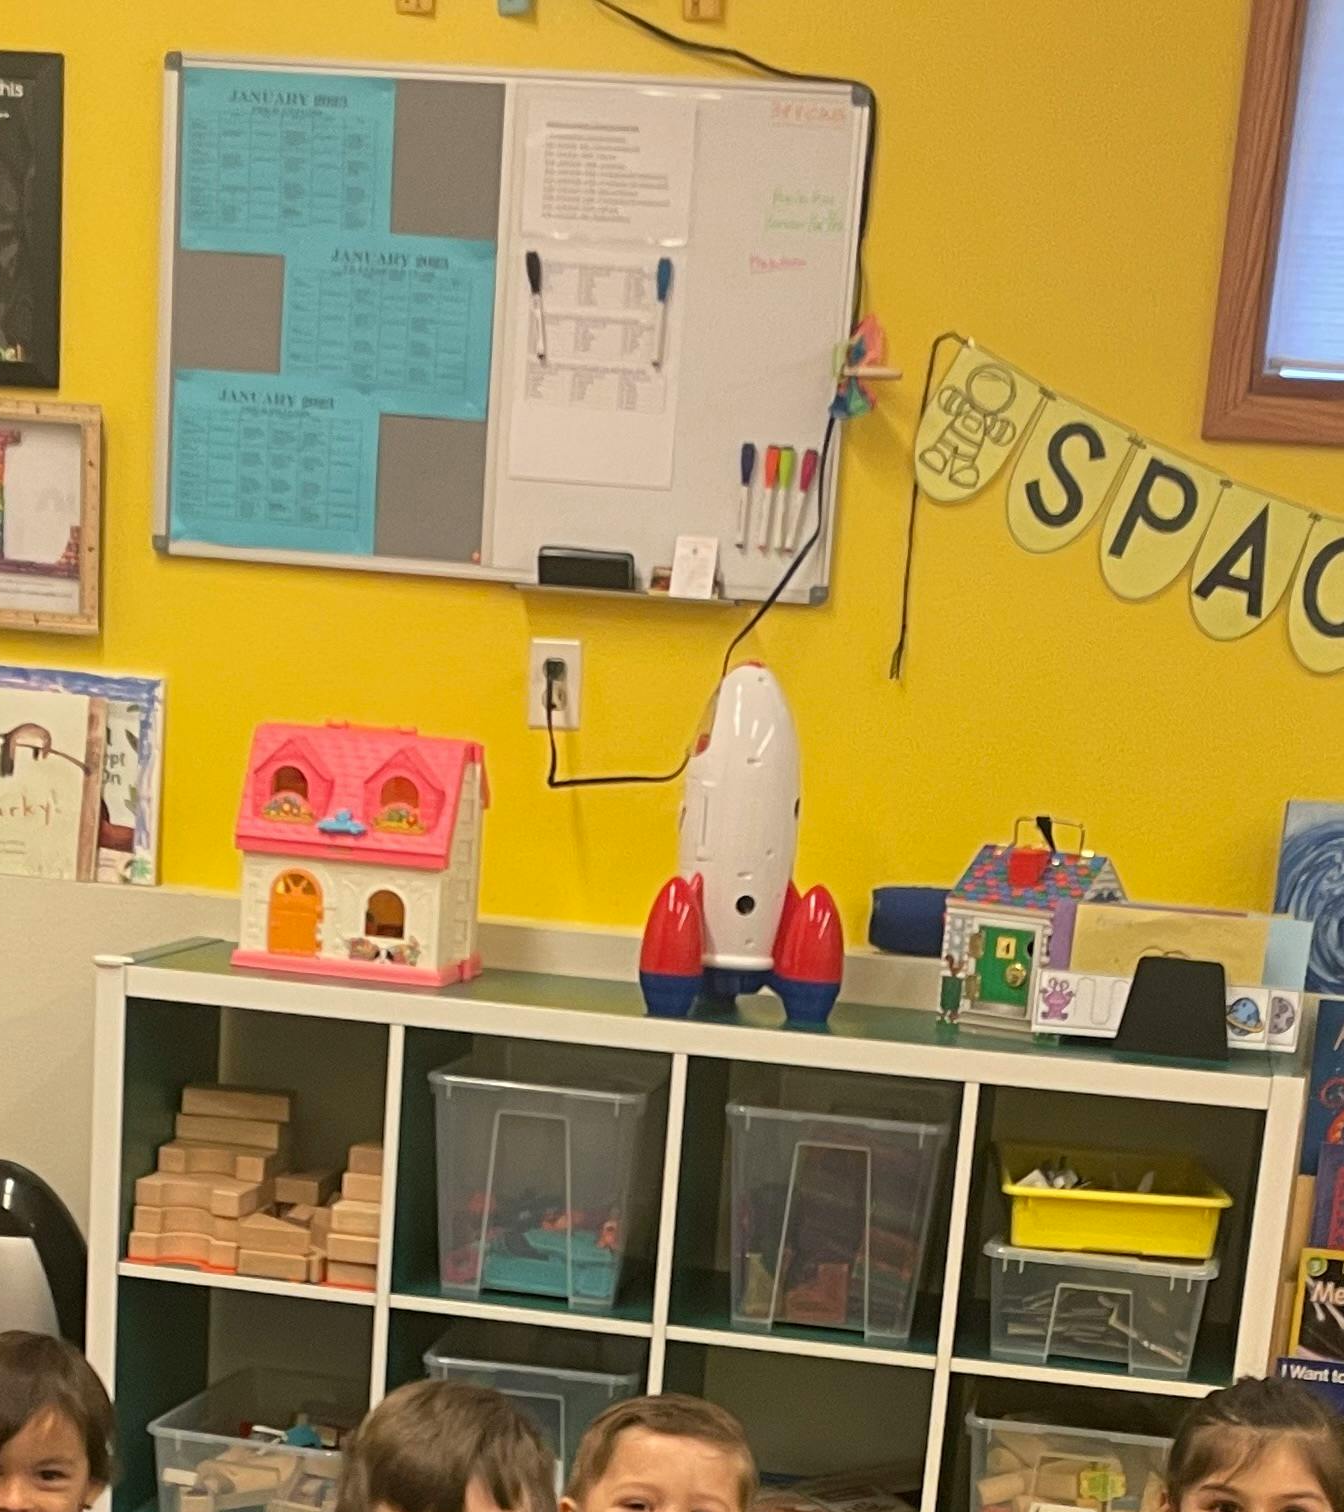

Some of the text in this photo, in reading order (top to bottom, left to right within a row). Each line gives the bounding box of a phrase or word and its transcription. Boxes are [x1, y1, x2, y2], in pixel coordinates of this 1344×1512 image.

[229, 89, 307, 107] JANUARY
[330, 248, 408, 268] JANUARY
[218, 388, 295, 409] JANUARY
[1281, 1363, 1288, 1378] I
[1290, 1364, 1330, 1383] Want
